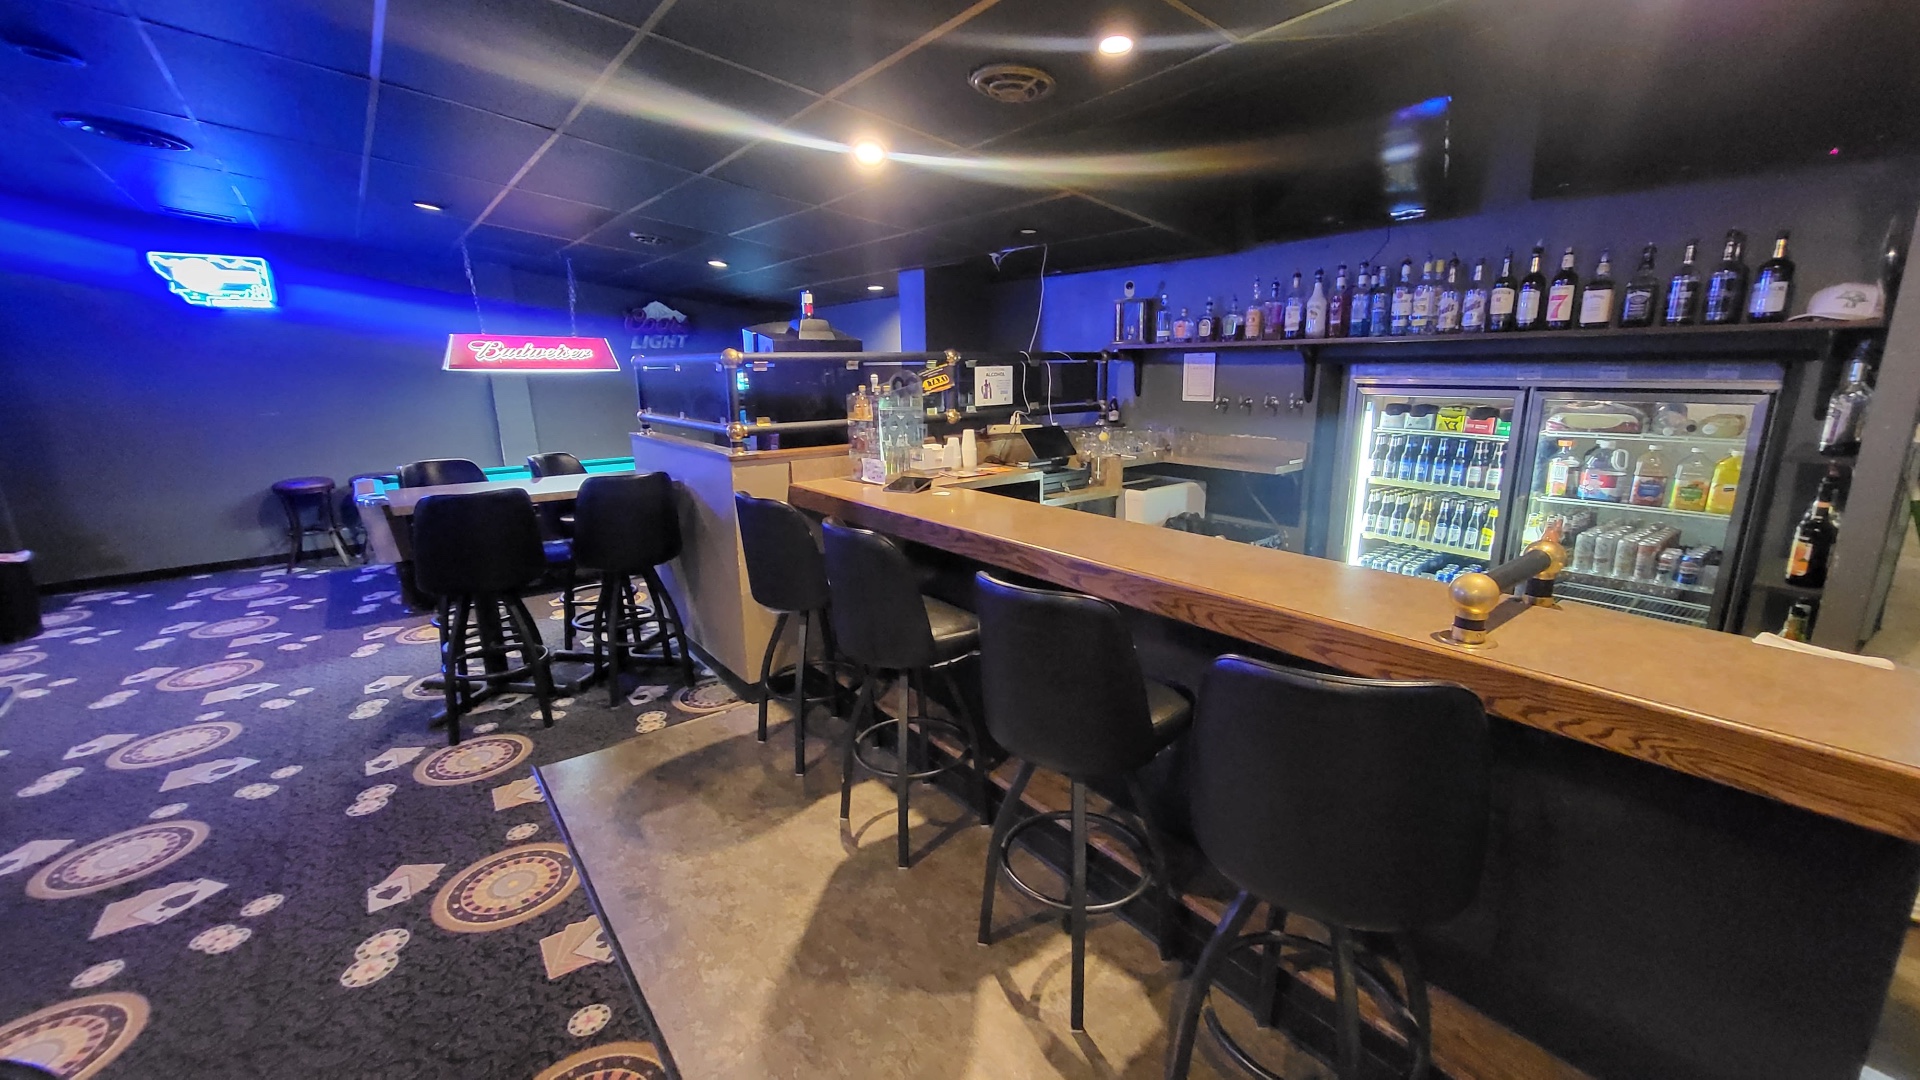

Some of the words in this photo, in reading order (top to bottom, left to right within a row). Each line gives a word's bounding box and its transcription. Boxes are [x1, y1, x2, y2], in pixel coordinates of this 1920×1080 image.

[630, 334, 688, 349] LIGHT
[468, 340, 593, 362] Budweiser
[927, 375, 948, 387] TAXI
